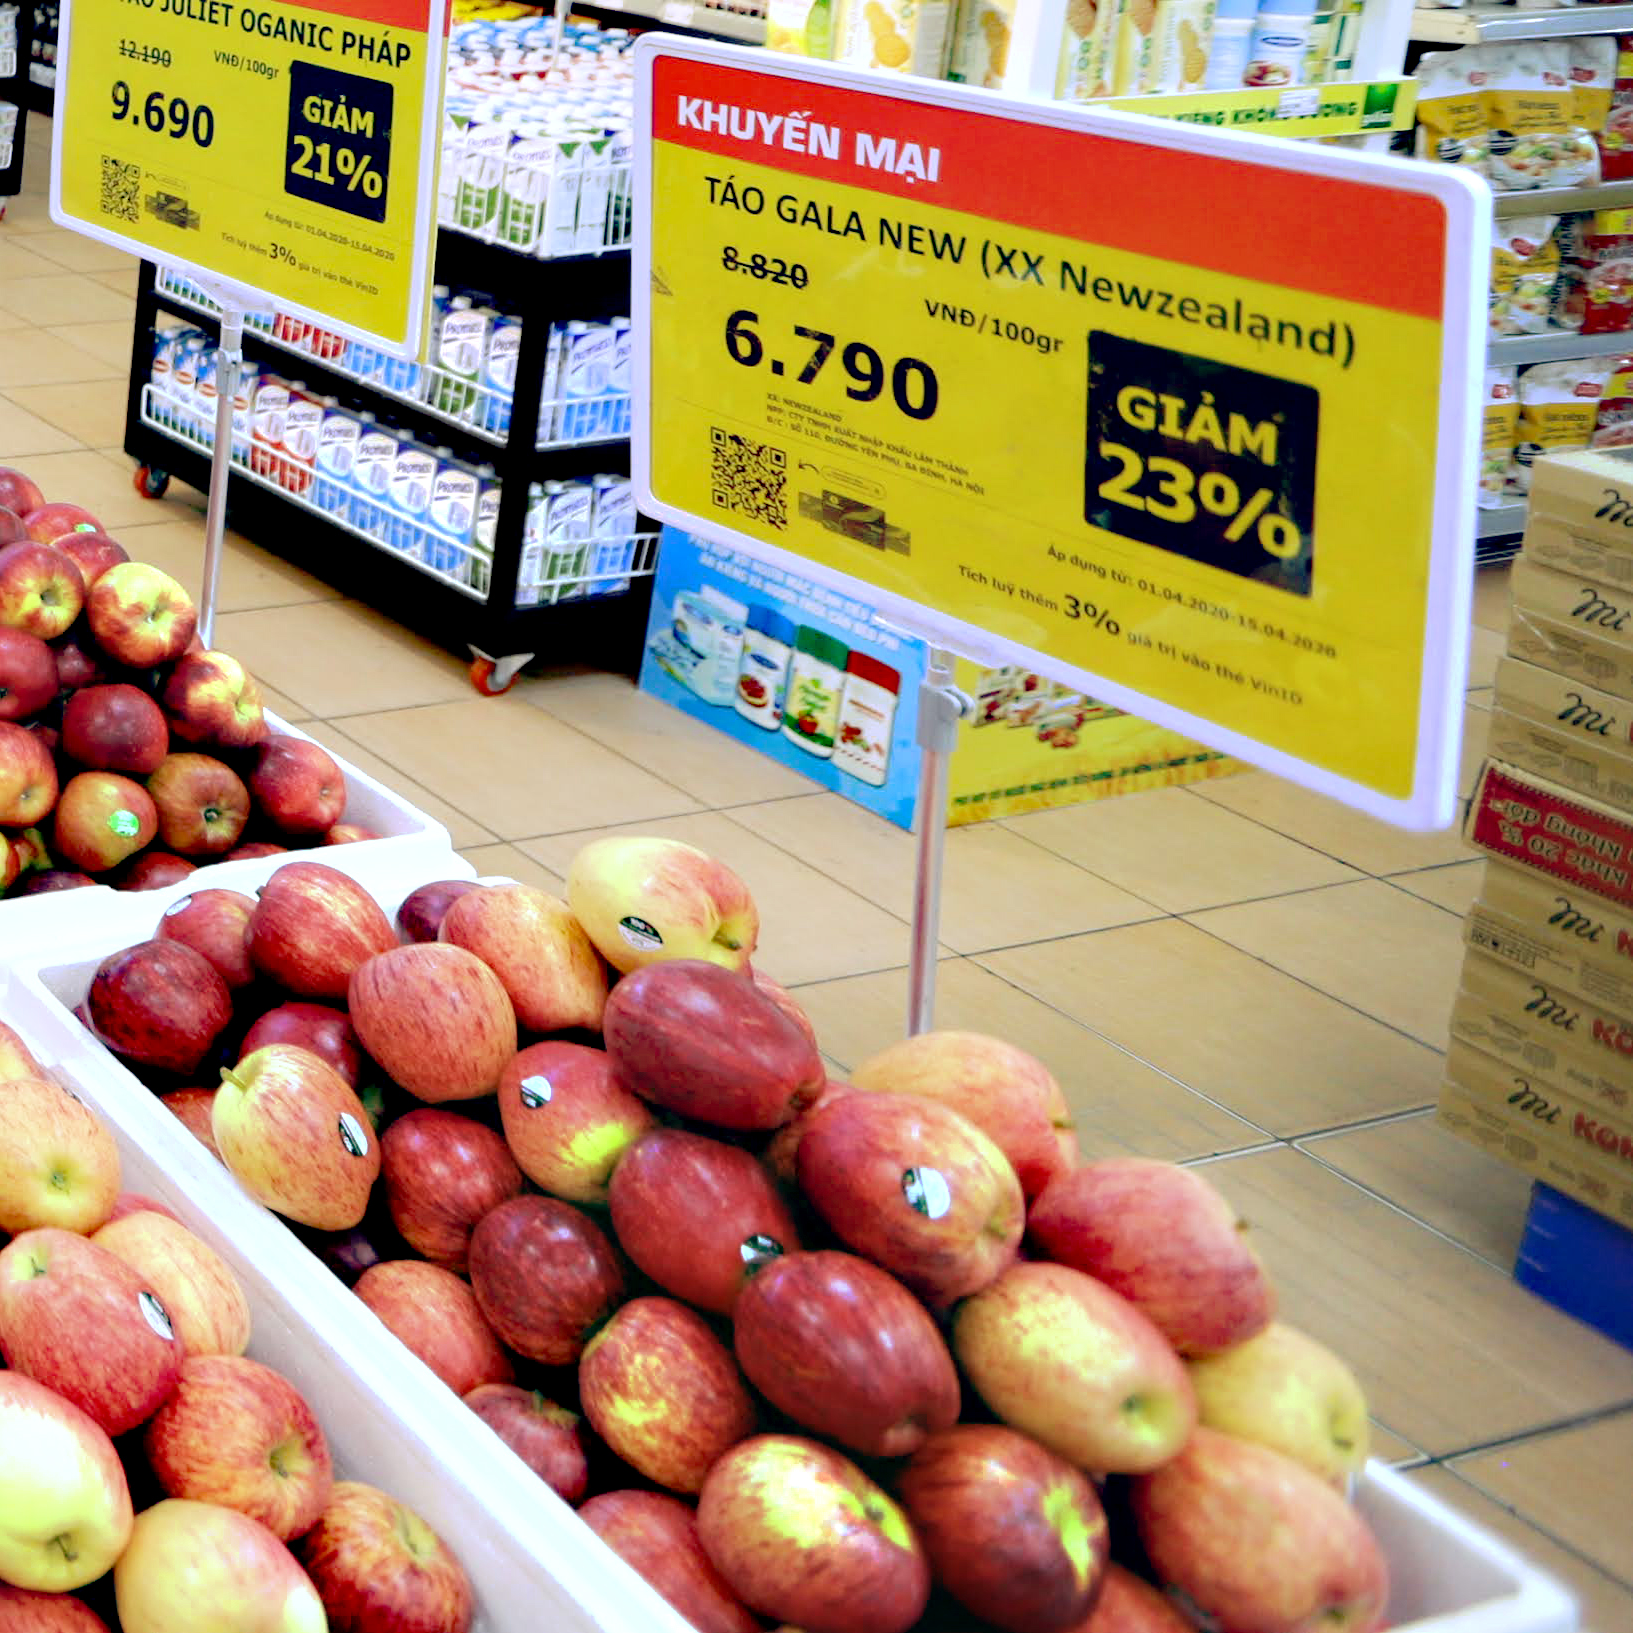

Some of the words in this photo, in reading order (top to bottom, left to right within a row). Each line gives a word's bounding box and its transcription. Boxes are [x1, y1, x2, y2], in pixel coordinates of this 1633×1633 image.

[119, 39, 172, 68] 12.190
[214, 50, 279, 80] VNĐ/100gr
[241, 8, 333, 52] OGANIC
[341, 29, 412, 70] PHÁP
[111, 81, 215, 149] 9.690
[303, 94, 374, 139] GIẢM
[678, 95, 841, 166] KHUYẾN
[853, 130, 942, 185] MẠI
[291, 136, 382, 199] 21%
[269, 242, 297, 267] 3%
[704, 175, 765, 219] TÁO
[775, 191, 866, 243] GALA
[879, 215, 967, 266] NEW
[980, 237, 1045, 290] (XX
[1060, 263, 1357, 370] Newzealand)
[721, 244, 810, 291] 8.820
[924, 298, 1065, 356] VNĐ/100gr
[725, 309, 941, 422] 6.790
[1117, 385, 1280, 463] GIẢM
[1098, 443, 1302, 563] 23%
[958, 563, 989, 587] Tích
[1019, 584, 1059, 613] thêm
[1063, 594, 1121, 637] 3%
[1070, 551, 1107, 580] dụng
